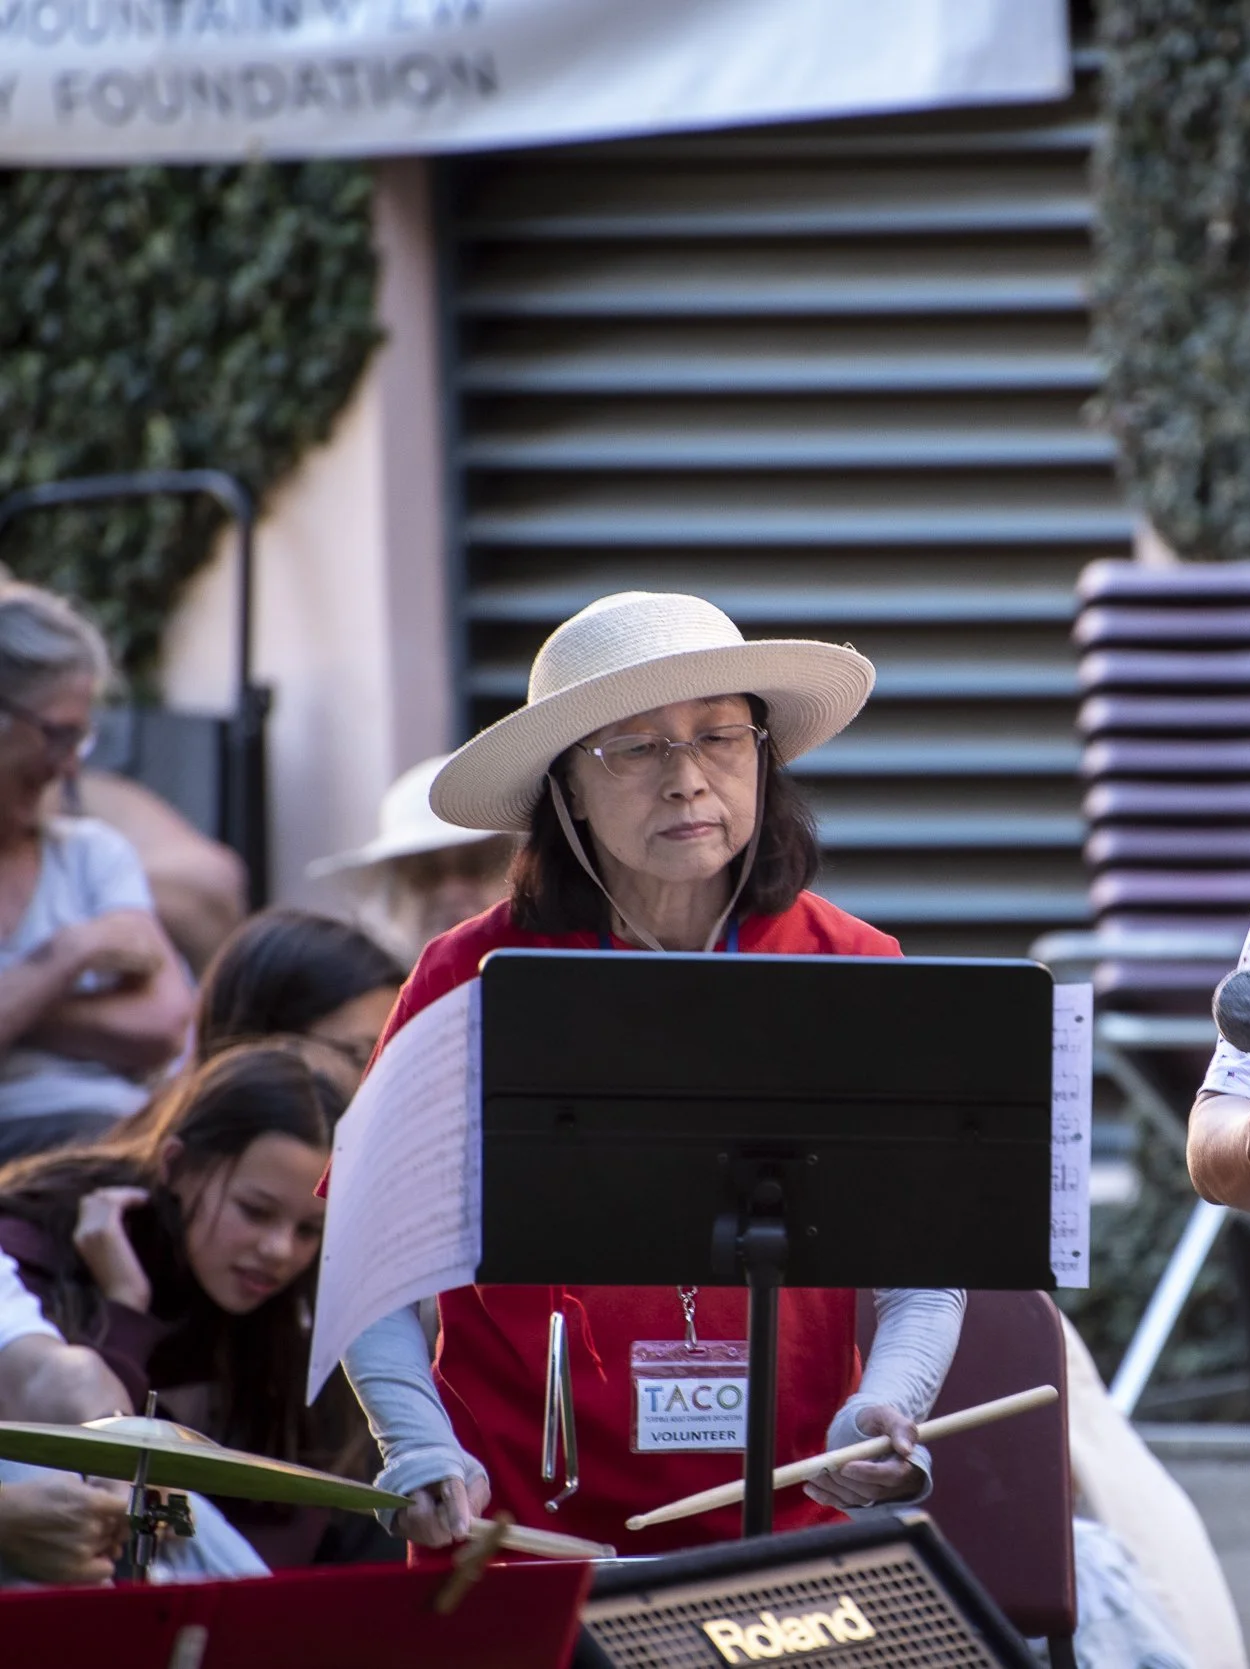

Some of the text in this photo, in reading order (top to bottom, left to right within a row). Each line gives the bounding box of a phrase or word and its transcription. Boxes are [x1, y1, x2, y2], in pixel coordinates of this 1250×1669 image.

[54, 50, 498, 126] FOUNDATION
[644, 1384, 743, 1412] TACO
[651, 1430, 737, 1442] VOLUNTEER
[702, 1595, 876, 1664] Roland
